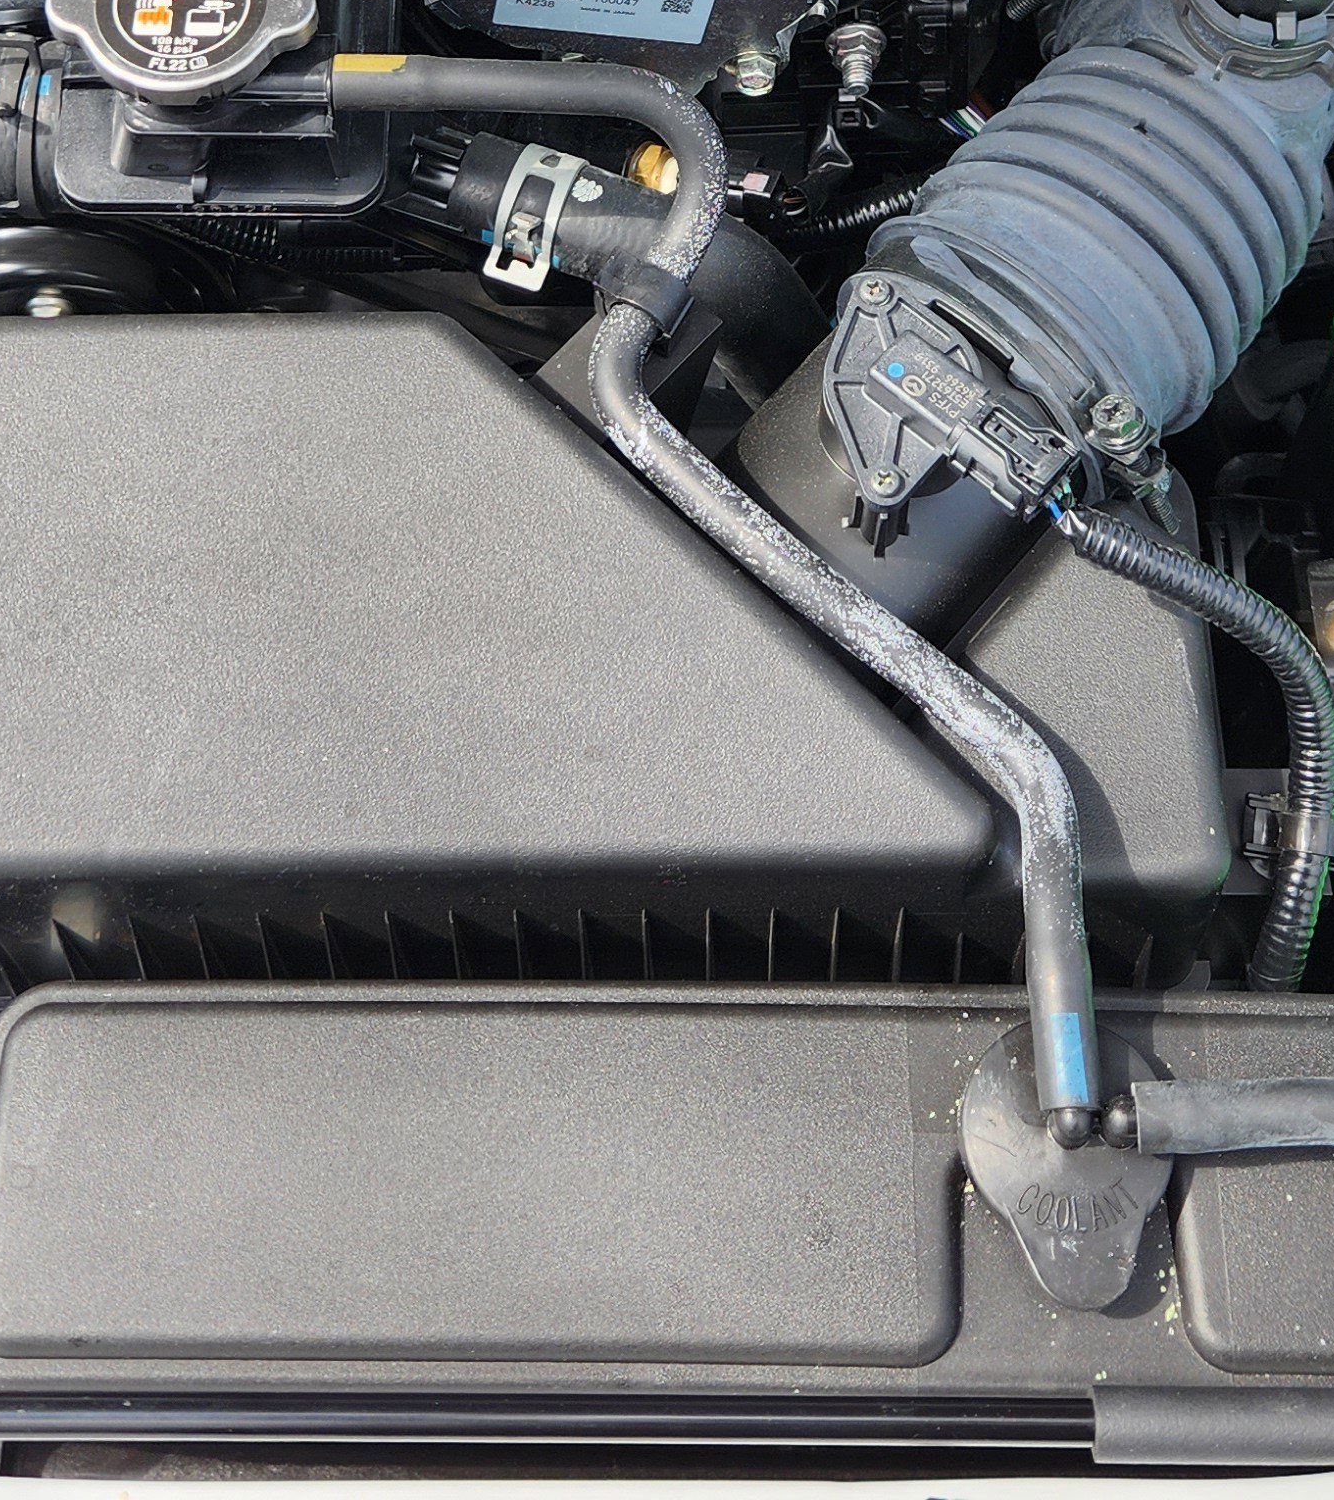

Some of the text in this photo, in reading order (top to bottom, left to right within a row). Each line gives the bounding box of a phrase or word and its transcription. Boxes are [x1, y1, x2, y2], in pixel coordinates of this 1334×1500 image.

[148, 56, 188, 72] FL22
[928, 392, 961, 419] PYFS
[1016, 1177, 1139, 1233] COOLANT
